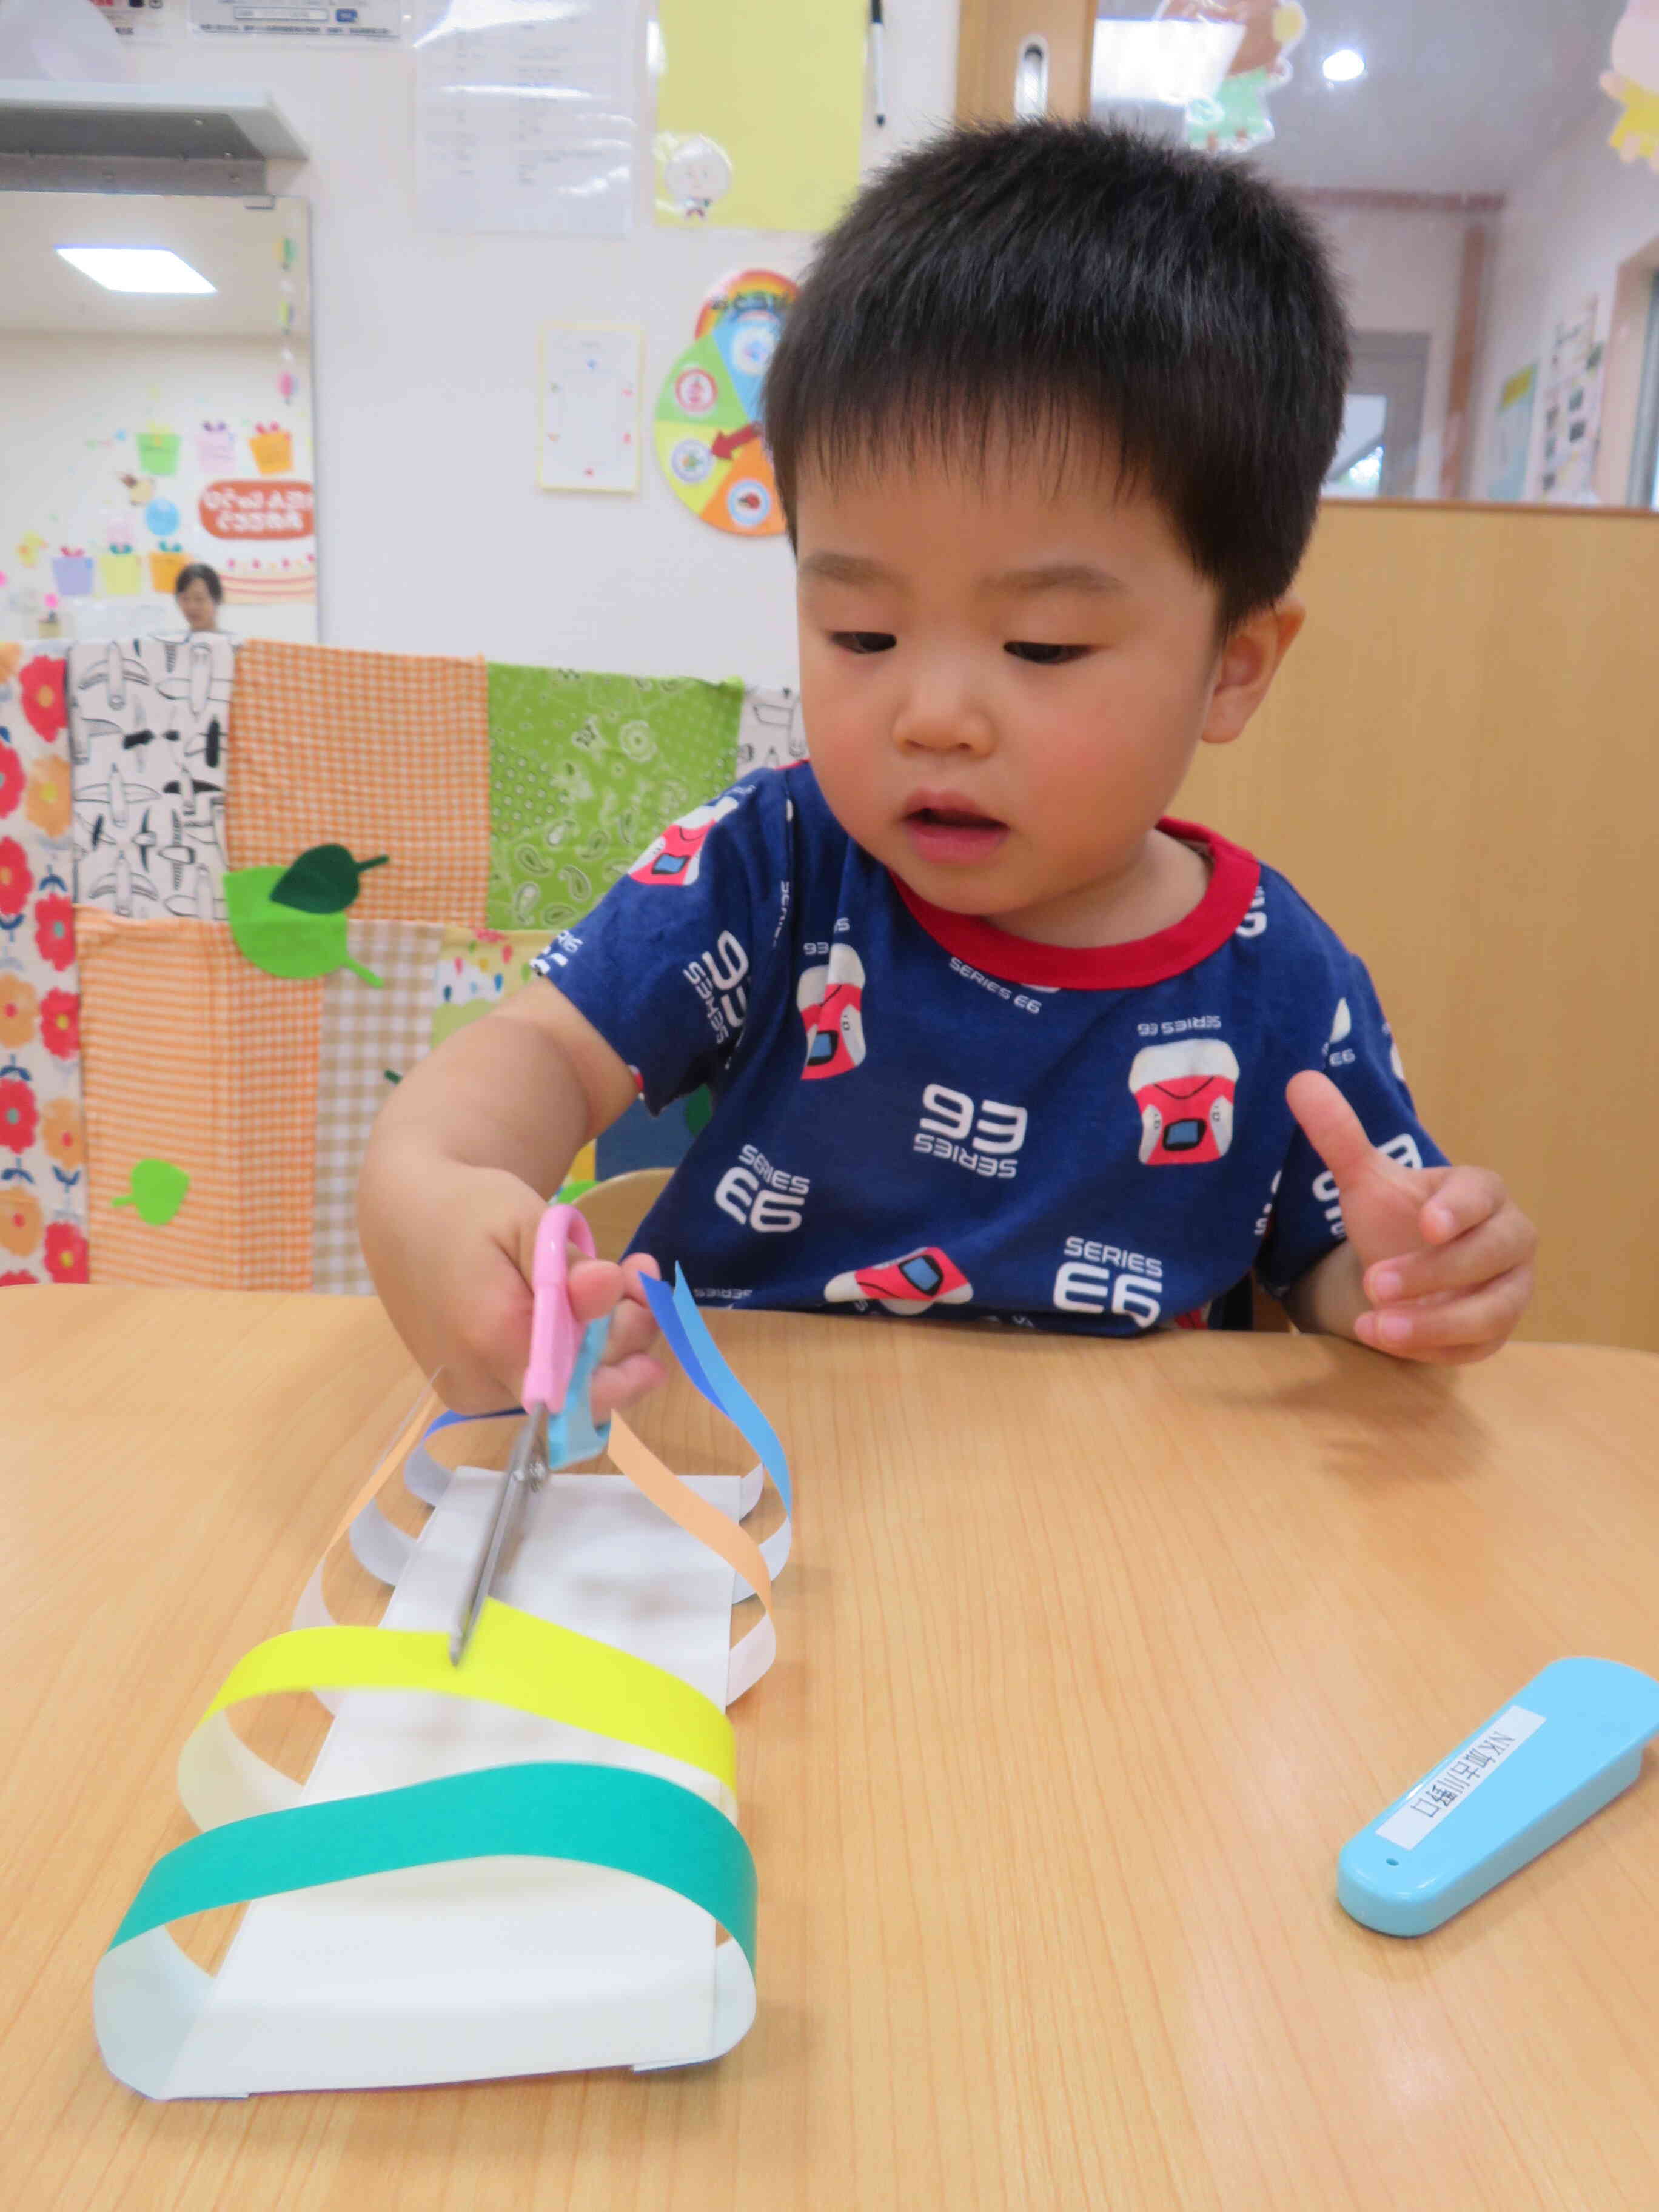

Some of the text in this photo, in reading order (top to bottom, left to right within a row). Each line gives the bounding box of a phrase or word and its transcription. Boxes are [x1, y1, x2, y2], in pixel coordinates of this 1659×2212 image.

[949, 956, 1042, 1015] SERIES E6
[1161, 1014, 1222, 1036] SERIES
[1329, 1048, 1356, 1067] E6
[919, 1083, 1028, 1154] E6
[737, 1144, 811, 1195] SERIES
[913, 1133, 1018, 1178] SERIES
[714, 1167, 805, 1233] E6
[1063, 1236, 1163, 1278] SERIES
[1053, 1261, 1163, 1328] E6
